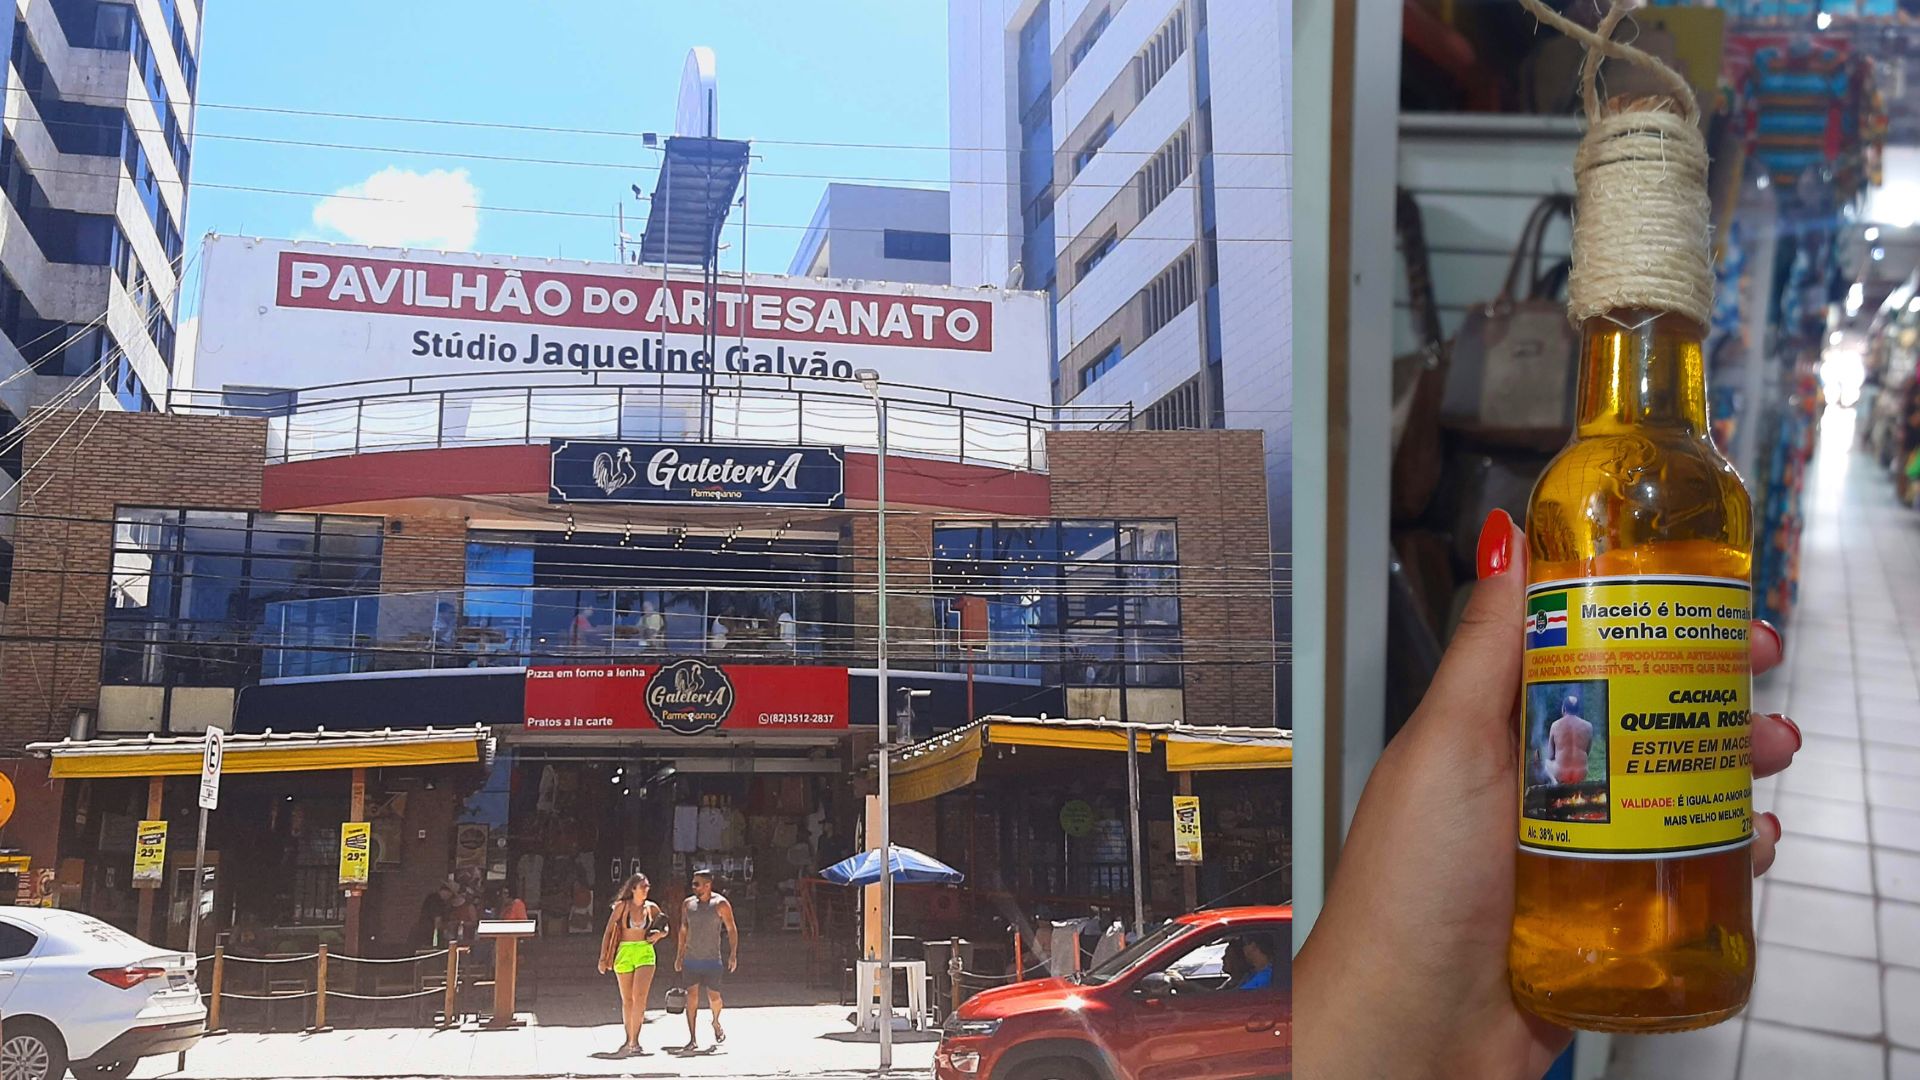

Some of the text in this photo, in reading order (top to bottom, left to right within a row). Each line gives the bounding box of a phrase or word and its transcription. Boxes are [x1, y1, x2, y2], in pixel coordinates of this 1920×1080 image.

[290, 261, 979, 342] PAVILHÃO DO ARTESANATO
[412, 330, 853, 379] Stúdio Jaqueline Galvão
[1582, 601, 1651, 619] Maceió
[1658, 602, 1669, 617] é
[1675, 602, 1712, 618] bom
[1598, 623, 1667, 640] venha
[1620, 651, 1684, 660] PRODUZIDA
[527, 668, 554, 678] Pizza
[557, 670, 573, 678] em
[575, 668, 604, 677] forno
[616, 668, 645, 677] lenha
[1652, 663, 1694, 674] QUENTE
[1696, 663, 1715, 674] QUE
[1669, 689, 1737, 706] CACHAÇA
[527, 717, 561, 727] Pratos
[573, 717, 583, 726] la
[585, 718, 613, 726] carte
[769, 713, 834, 724] (82)3512-2837
[1621, 709, 1751, 731] QUEIMA ROSC
[1632, 736, 1750, 755] ESTIVE EM MACE
[1626, 752, 1751, 774] E LEMBREI DE VOC
[1621, 797, 1674, 809] VALIDADE:
[1678, 794, 1684, 806] É
[1686, 795, 1711, 806] IGUAL
[1713, 792, 1724, 802] AO
[1725, 789, 1743, 801] AMOR
[1664, 815, 1687, 826] MAIS
[1689, 812, 1717, 824] VELHO
[1539, 827, 1554, 841] 38%
[1556, 830, 1571, 842] vol.
